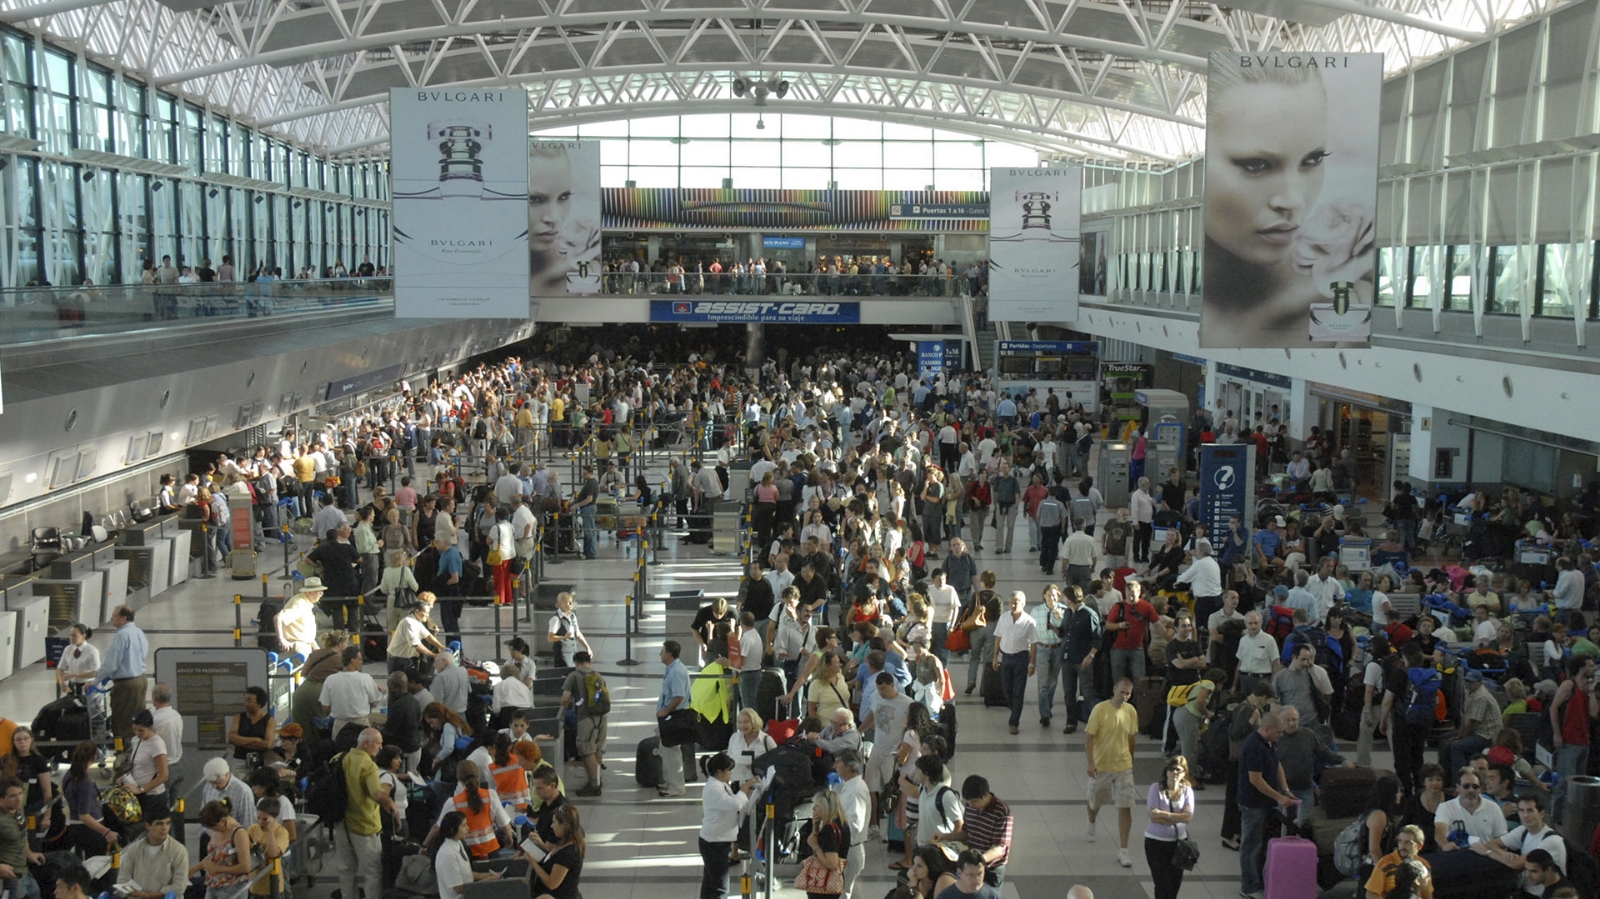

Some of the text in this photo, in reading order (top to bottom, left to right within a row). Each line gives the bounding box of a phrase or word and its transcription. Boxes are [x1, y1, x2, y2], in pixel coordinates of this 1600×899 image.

[1240, 56, 1348, 68] BVLGARI
[417, 92, 503, 102] BVLGARI
[431, 239, 492, 247] BVLGARI
[788, 314, 805, 322] viaje
[1108, 364, 1141, 372] TrueStar
